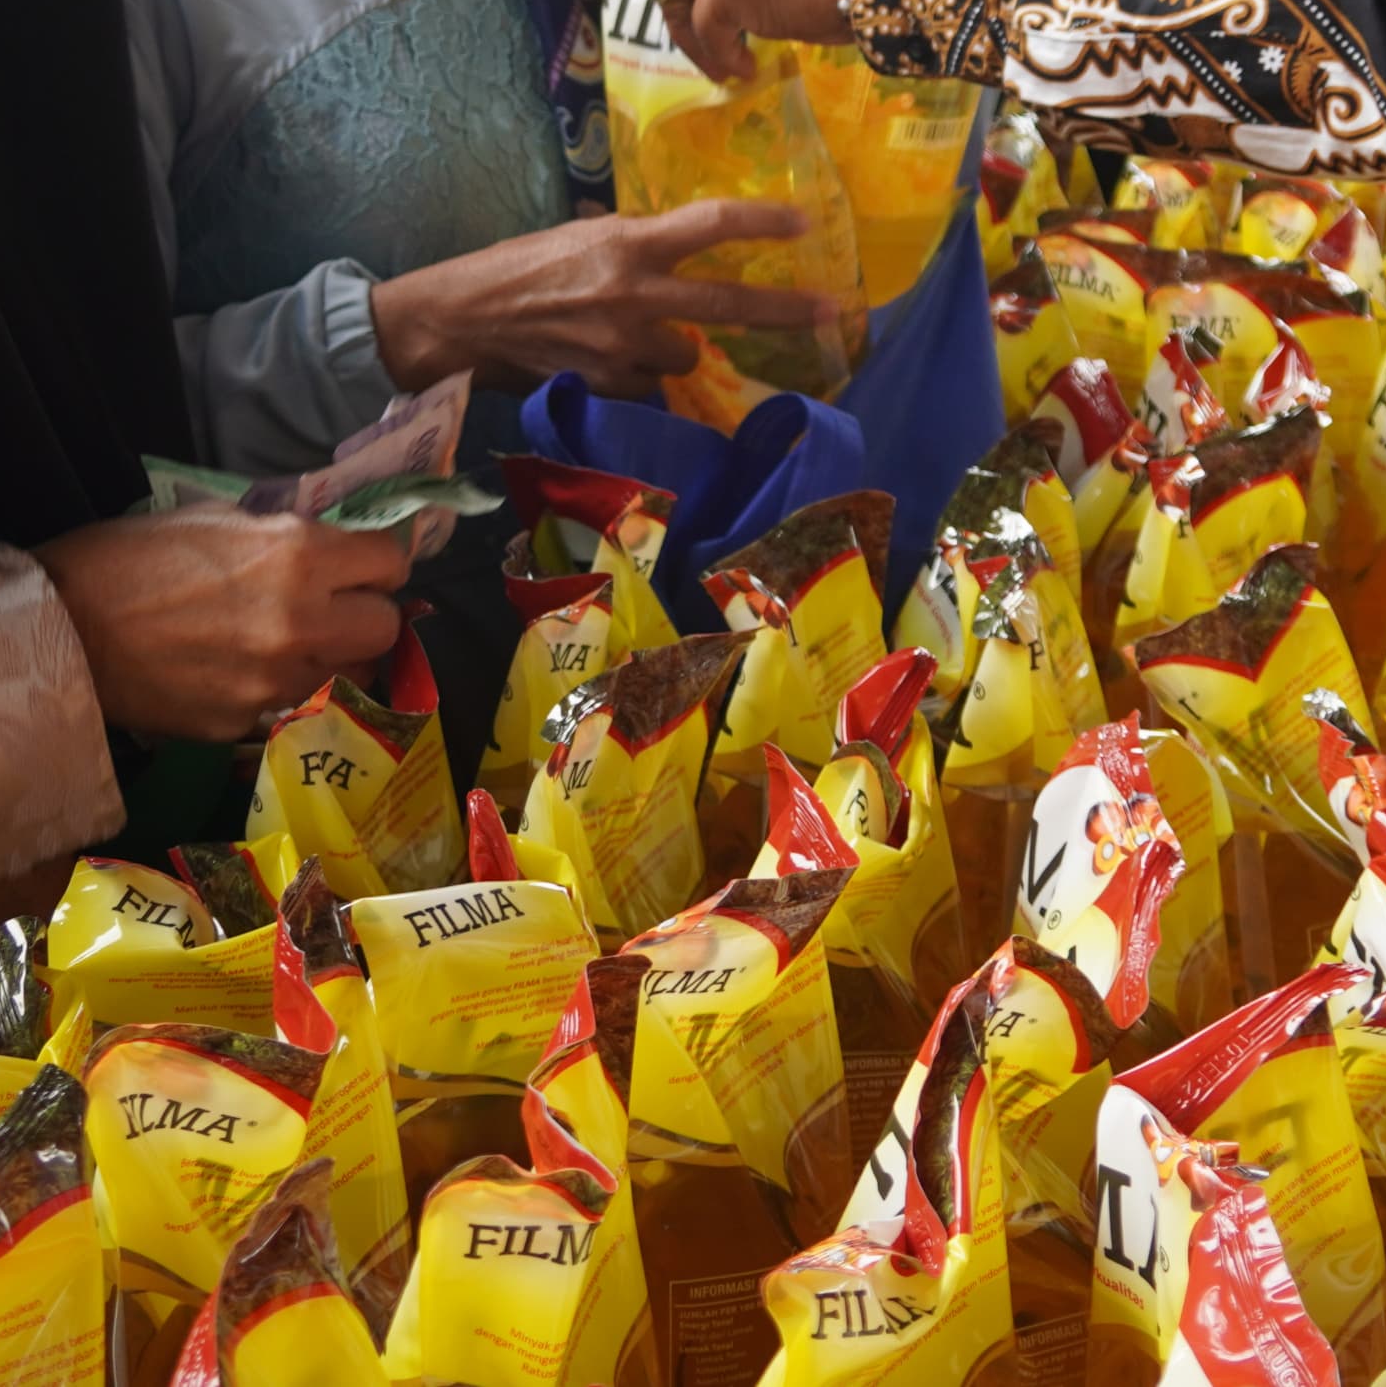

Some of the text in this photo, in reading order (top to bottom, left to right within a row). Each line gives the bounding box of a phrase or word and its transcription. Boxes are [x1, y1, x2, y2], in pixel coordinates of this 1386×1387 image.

[112, 884, 197, 950] FILM
[404, 888, 525, 948] FILMA
[463, 1222, 600, 1266] FILM
[689, 1279, 756, 1300] INFORMASI
[473, 1326, 564, 1366] dengan menge
[509, 1327, 552, 1352] Minyak
[521, 1362, 559, 1380] Ratusa
